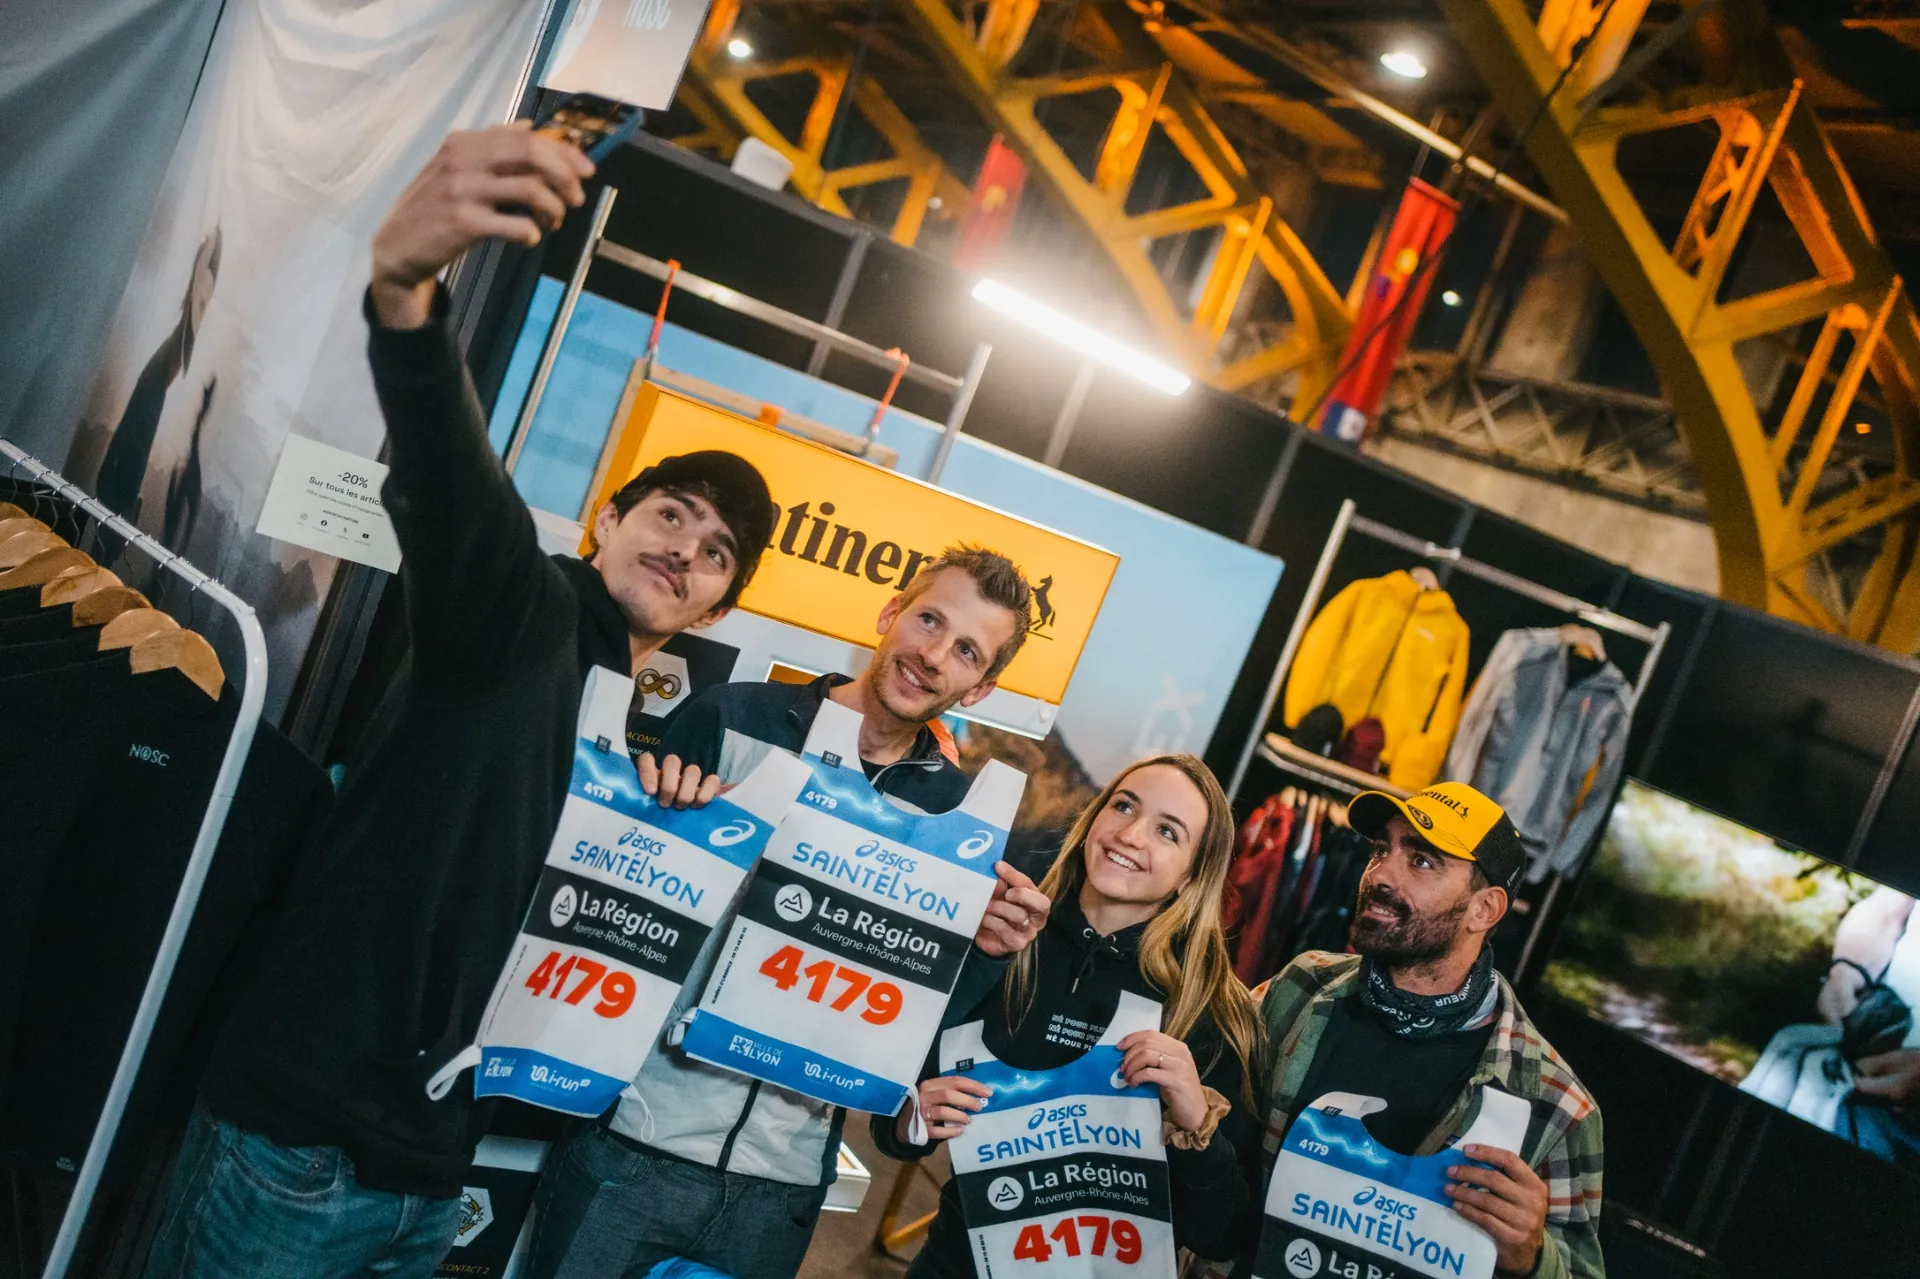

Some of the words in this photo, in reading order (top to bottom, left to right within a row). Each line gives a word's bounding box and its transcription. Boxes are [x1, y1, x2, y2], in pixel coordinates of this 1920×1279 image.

[308, 476, 323, 487] Sur
[326, 482, 345, 494] tous
[346, 488, 358, 499] les
[337, 471, 369, 489] -20%
[627, 731, 661, 746] ACONTA
[128, 743, 170, 767] NOSC
[583, 781, 614, 802] 4179
[804, 790, 838, 810] 4179
[631, 833, 667, 857] asics
[875, 847, 918, 874] asics
[570, 839, 704, 909] SAINTÉLYON
[791, 841, 960, 921] SAINTÉLYON
[579, 890, 599, 918] La
[600, 898, 680, 947] Région
[818, 896, 850, 926] La
[852, 910, 941, 960] Région
[572, 921, 668, 964] Auvergne-Rhône-Alpes
[811, 922, 932, 976] Auvergne-Rhône-Alpes
[524, 951, 637, 1019] 4179
[758, 944, 904, 1026] 4179
[752, 1041, 772, 1054] VILLE
[772, 1048, 784, 1057] DE
[1045, 1034, 1057, 1042] NÉ
[1059, 1037, 1081, 1049] POUR
[749, 1047, 781, 1067] LYON
[547, 1069, 579, 1092] i-run
[822, 1067, 854, 1090] i-run
[1047, 1104, 1087, 1123] asics
[977, 1119, 1141, 1163] SAINTÉLYON
[1298, 1138, 1329, 1157] 4179
[1028, 1170, 1059, 1191] La
[1063, 1161, 1148, 1190] Région
[1034, 1188, 1149, 1206] Auvergne-Rhône-Alpes
[1374, 1193, 1418, 1221] asics
[1012, 1215, 1142, 1265] 4179
[1291, 1193, 1465, 1276] SAINTÉLYON
[482, 1267, 490, 1275] 2
[1328, 1250, 1359, 1279] La
